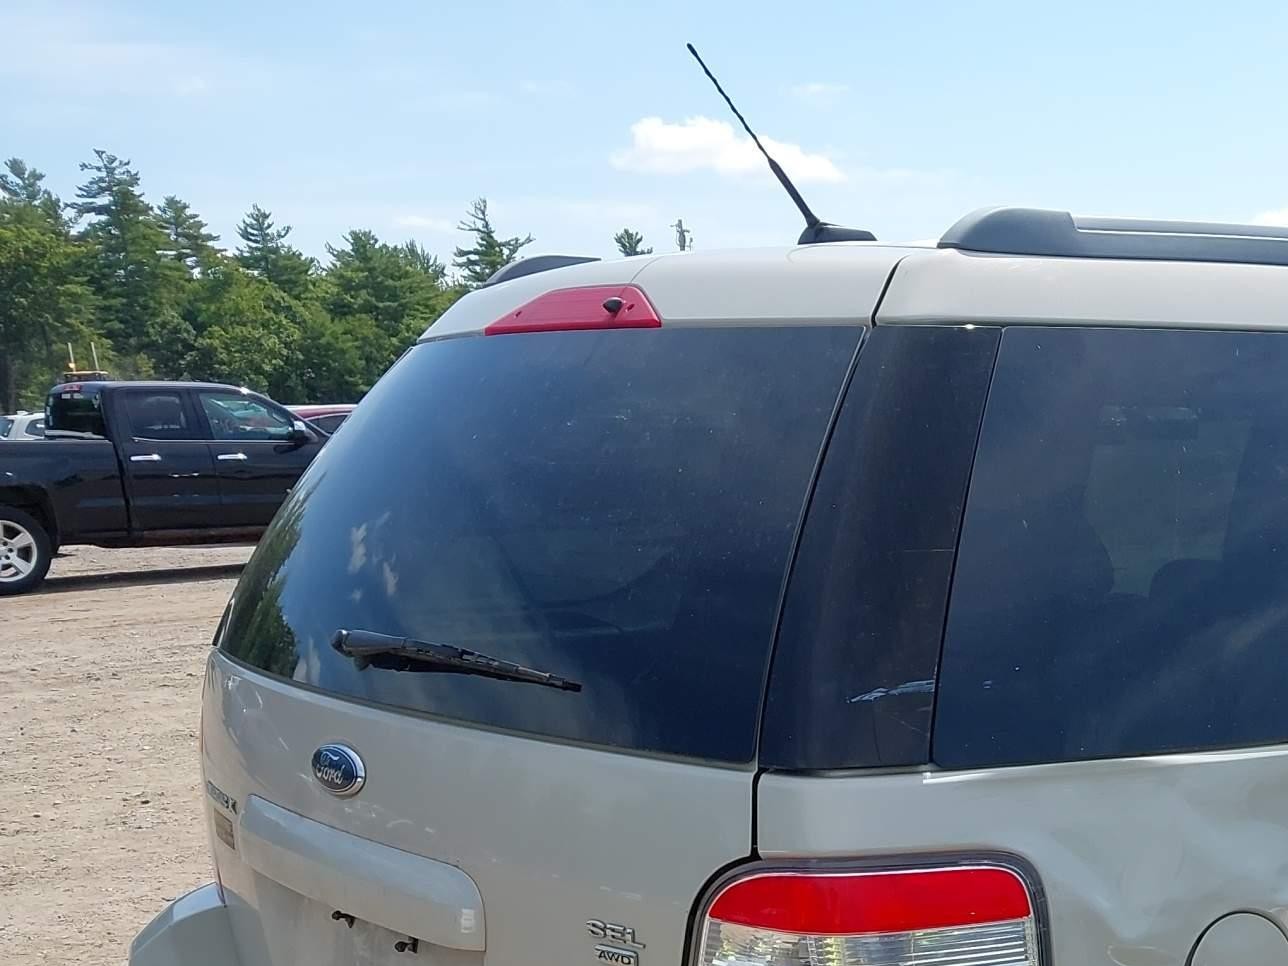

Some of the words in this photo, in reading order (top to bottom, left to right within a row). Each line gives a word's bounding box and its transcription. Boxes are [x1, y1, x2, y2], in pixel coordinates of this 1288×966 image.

[315, 751, 346, 784] Ford
[586, 918, 646, 950] SEL
[598, 950, 632, 966] AWD
